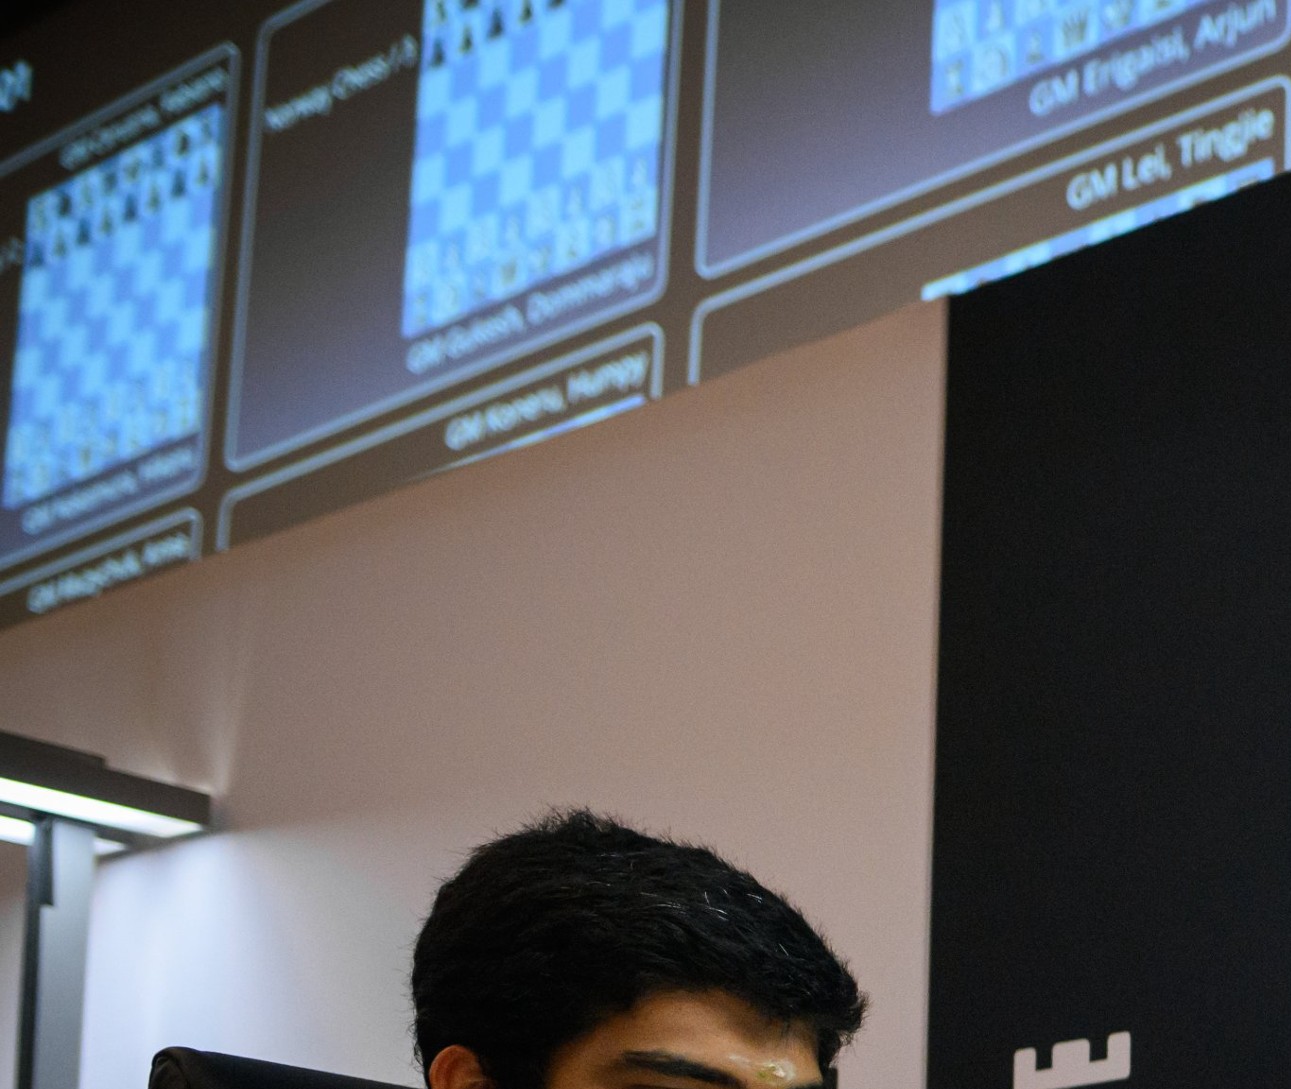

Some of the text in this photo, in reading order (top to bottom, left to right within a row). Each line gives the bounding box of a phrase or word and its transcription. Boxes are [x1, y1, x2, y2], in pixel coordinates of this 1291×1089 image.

[1066, 108, 1275, 210] GM Lei, Tingjie
